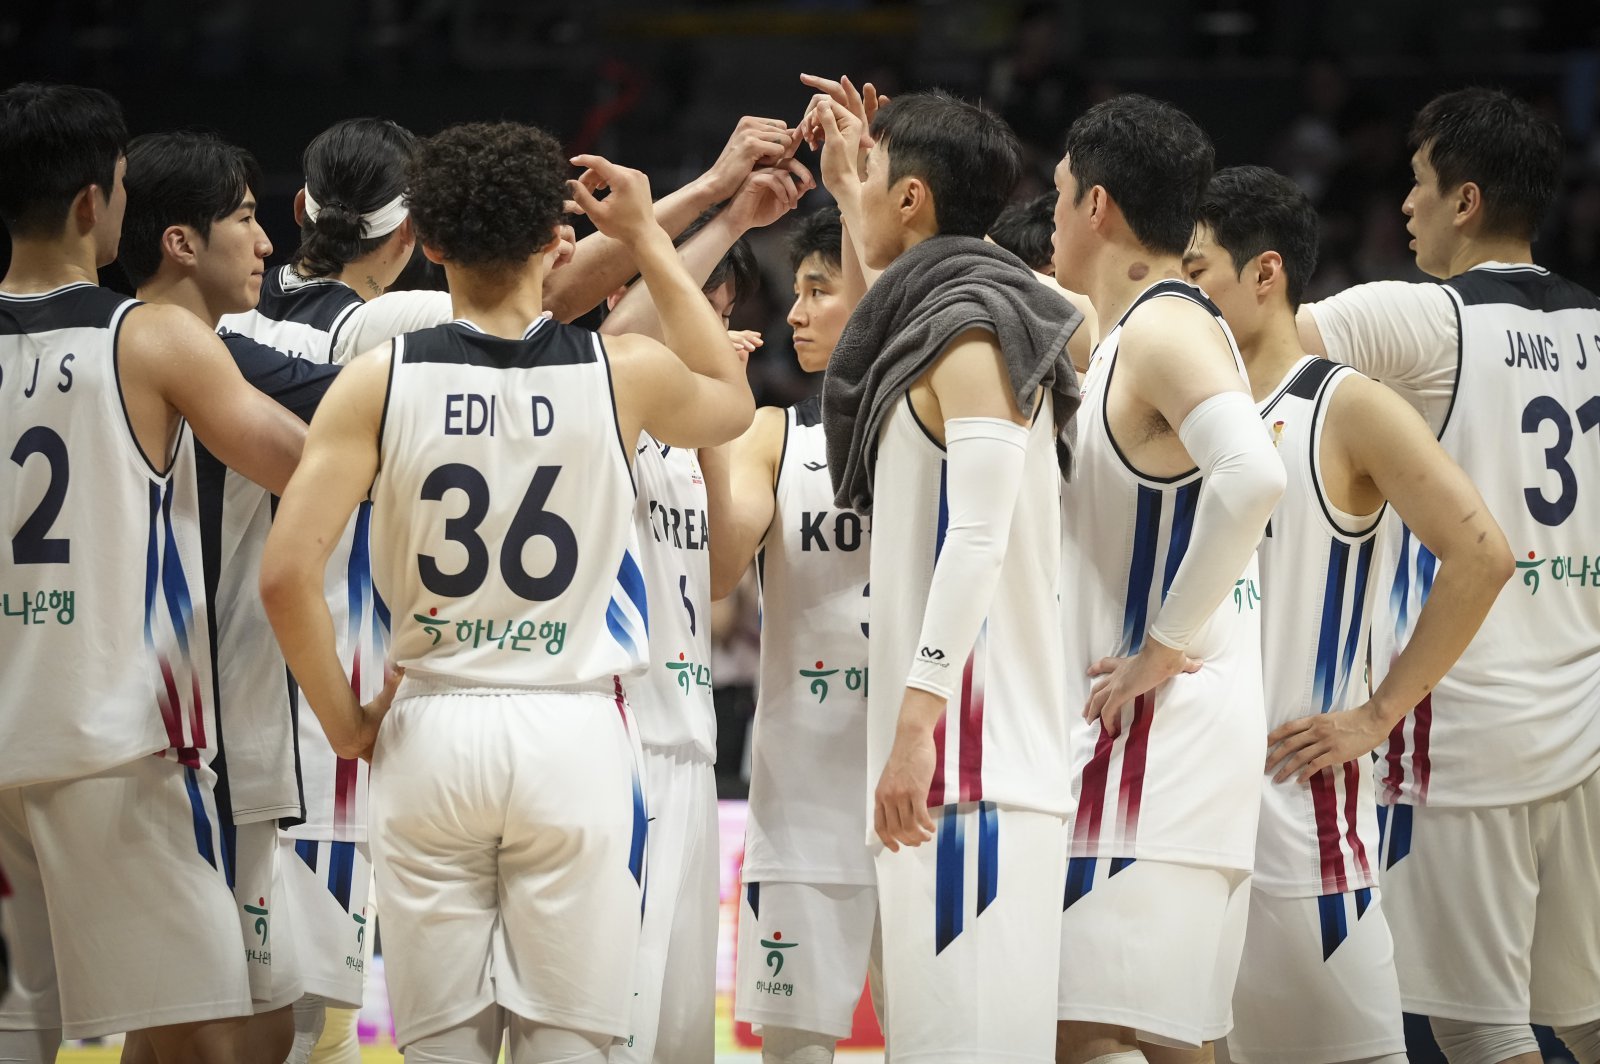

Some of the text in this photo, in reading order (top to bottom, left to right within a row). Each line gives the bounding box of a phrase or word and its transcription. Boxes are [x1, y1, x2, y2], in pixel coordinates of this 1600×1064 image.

[1504, 329, 1560, 372] JANG
[1576, 333, 1587, 370] J
[24, 356, 40, 398] J
[57, 352, 75, 393] S
[444, 393, 555, 437] EDI D
[10, 425, 70, 564] 2
[417, 462, 579, 602] 36
[0, 590, 76, 626] 나은행
[456, 618, 568, 656] 하나은행
